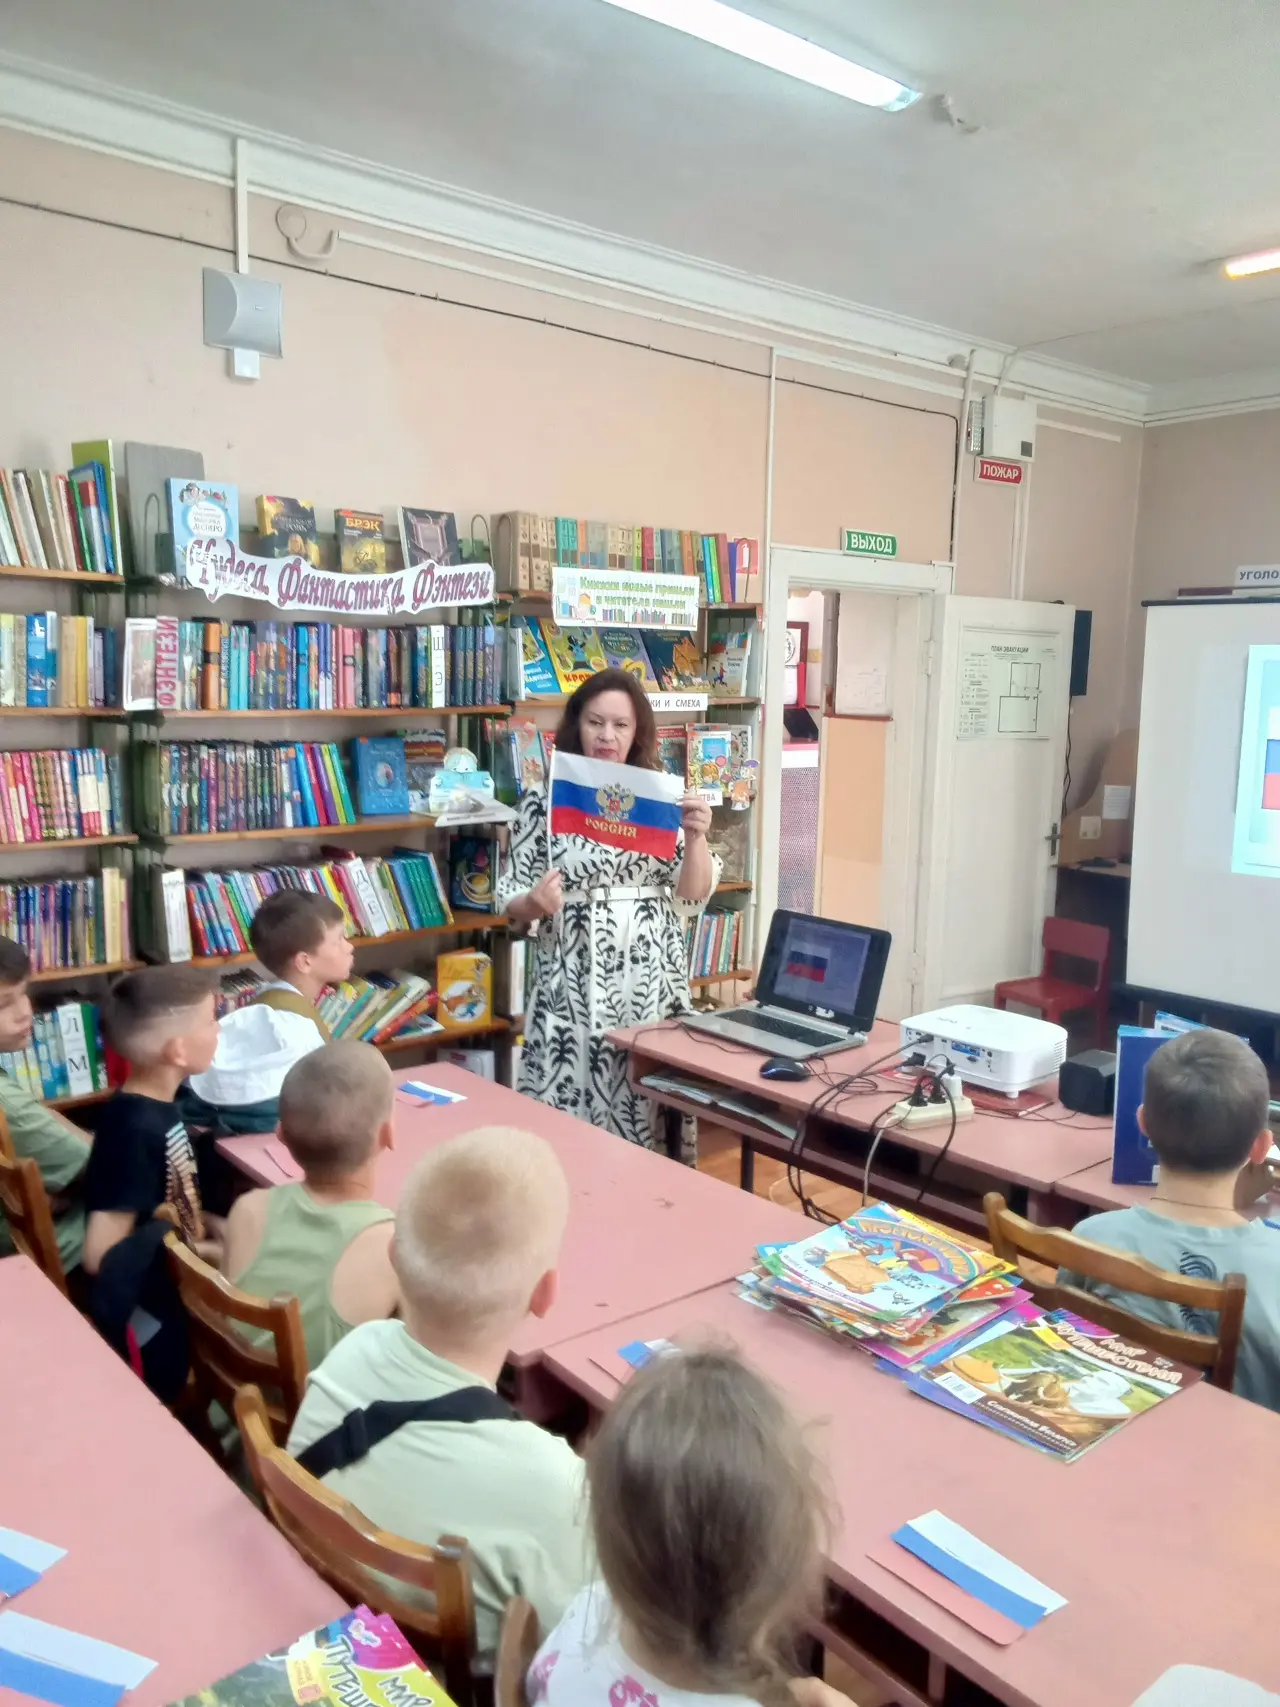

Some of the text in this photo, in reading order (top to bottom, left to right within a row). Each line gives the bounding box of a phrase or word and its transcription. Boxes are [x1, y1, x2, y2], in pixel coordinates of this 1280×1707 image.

[983, 464, 1019, 480] ПОЖАР
[345, 517, 381, 531] БРЭК
[851, 533, 893, 553] ВЫХОД
[411, 563, 491, 611] Фэнтези
[580, 576, 620, 590] Книжки
[622, 581, 653, 593] новые
[596, 595, 686, 609] и читателя нашли
[991, 645, 1003, 653] ПЛАН
[156, 619, 178, 706] ФЭНТЕЗИ
[434, 671, 443, 686] Э
[650, 699, 701, 708] КИ И СМЕХА
[703, 793, 716, 802] ТВА
[585, 816, 637, 838] РОССИЯ
[68, 1055, 88, 1073] М
[321, 1637, 380, 1707] ПУТЕШ
